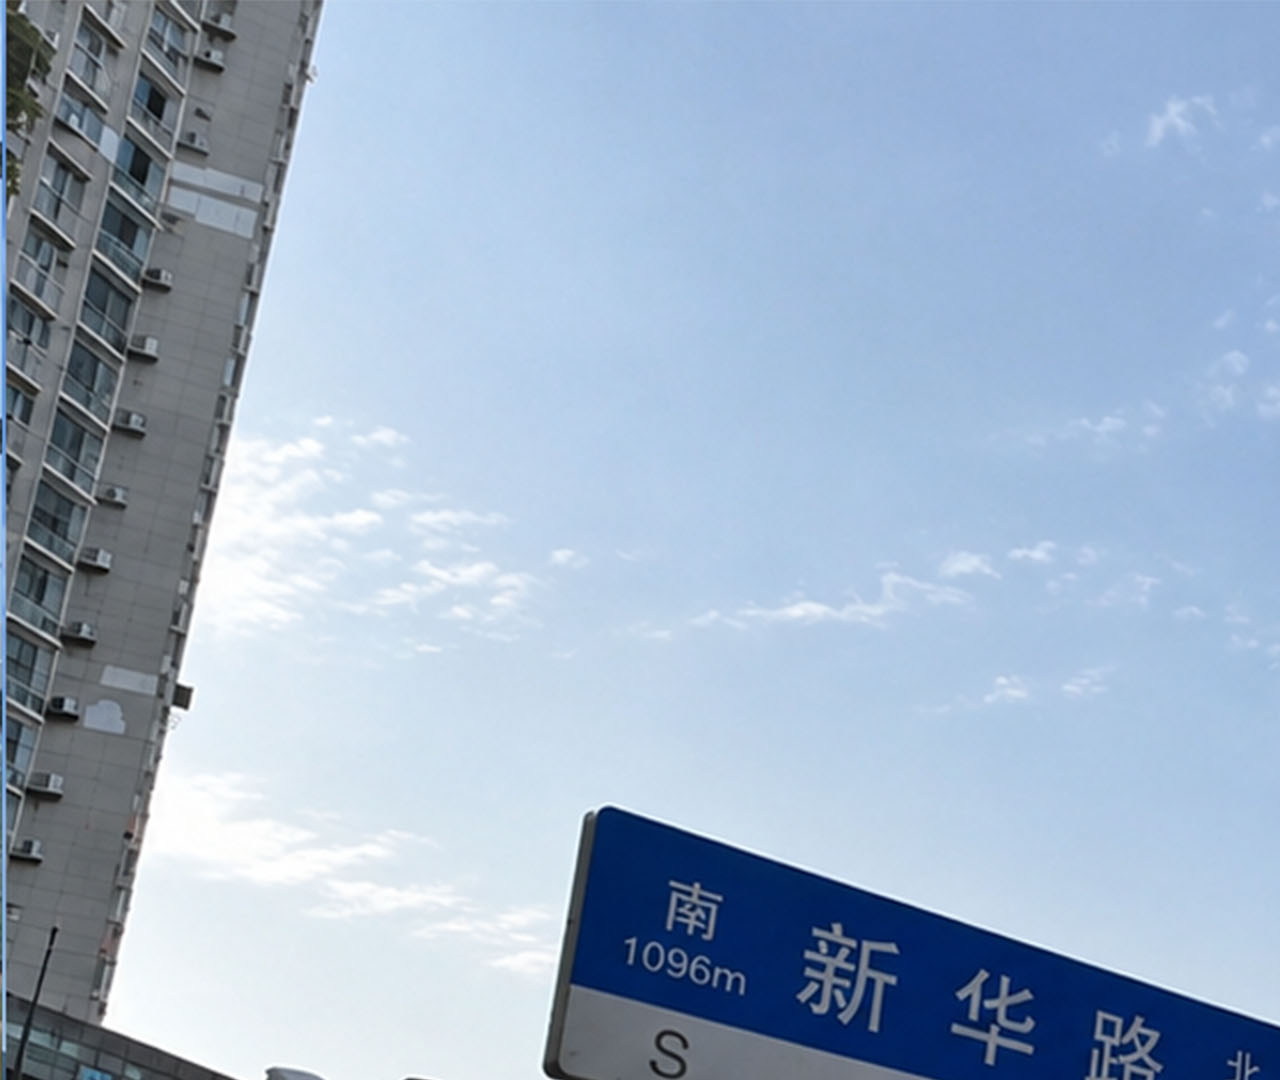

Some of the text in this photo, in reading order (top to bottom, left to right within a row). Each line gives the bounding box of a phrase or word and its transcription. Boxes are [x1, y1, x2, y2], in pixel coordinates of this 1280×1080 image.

[665, 879, 724, 942] 南
[624, 936, 748, 996] 1096m
[649, 1029, 690, 1080] S
